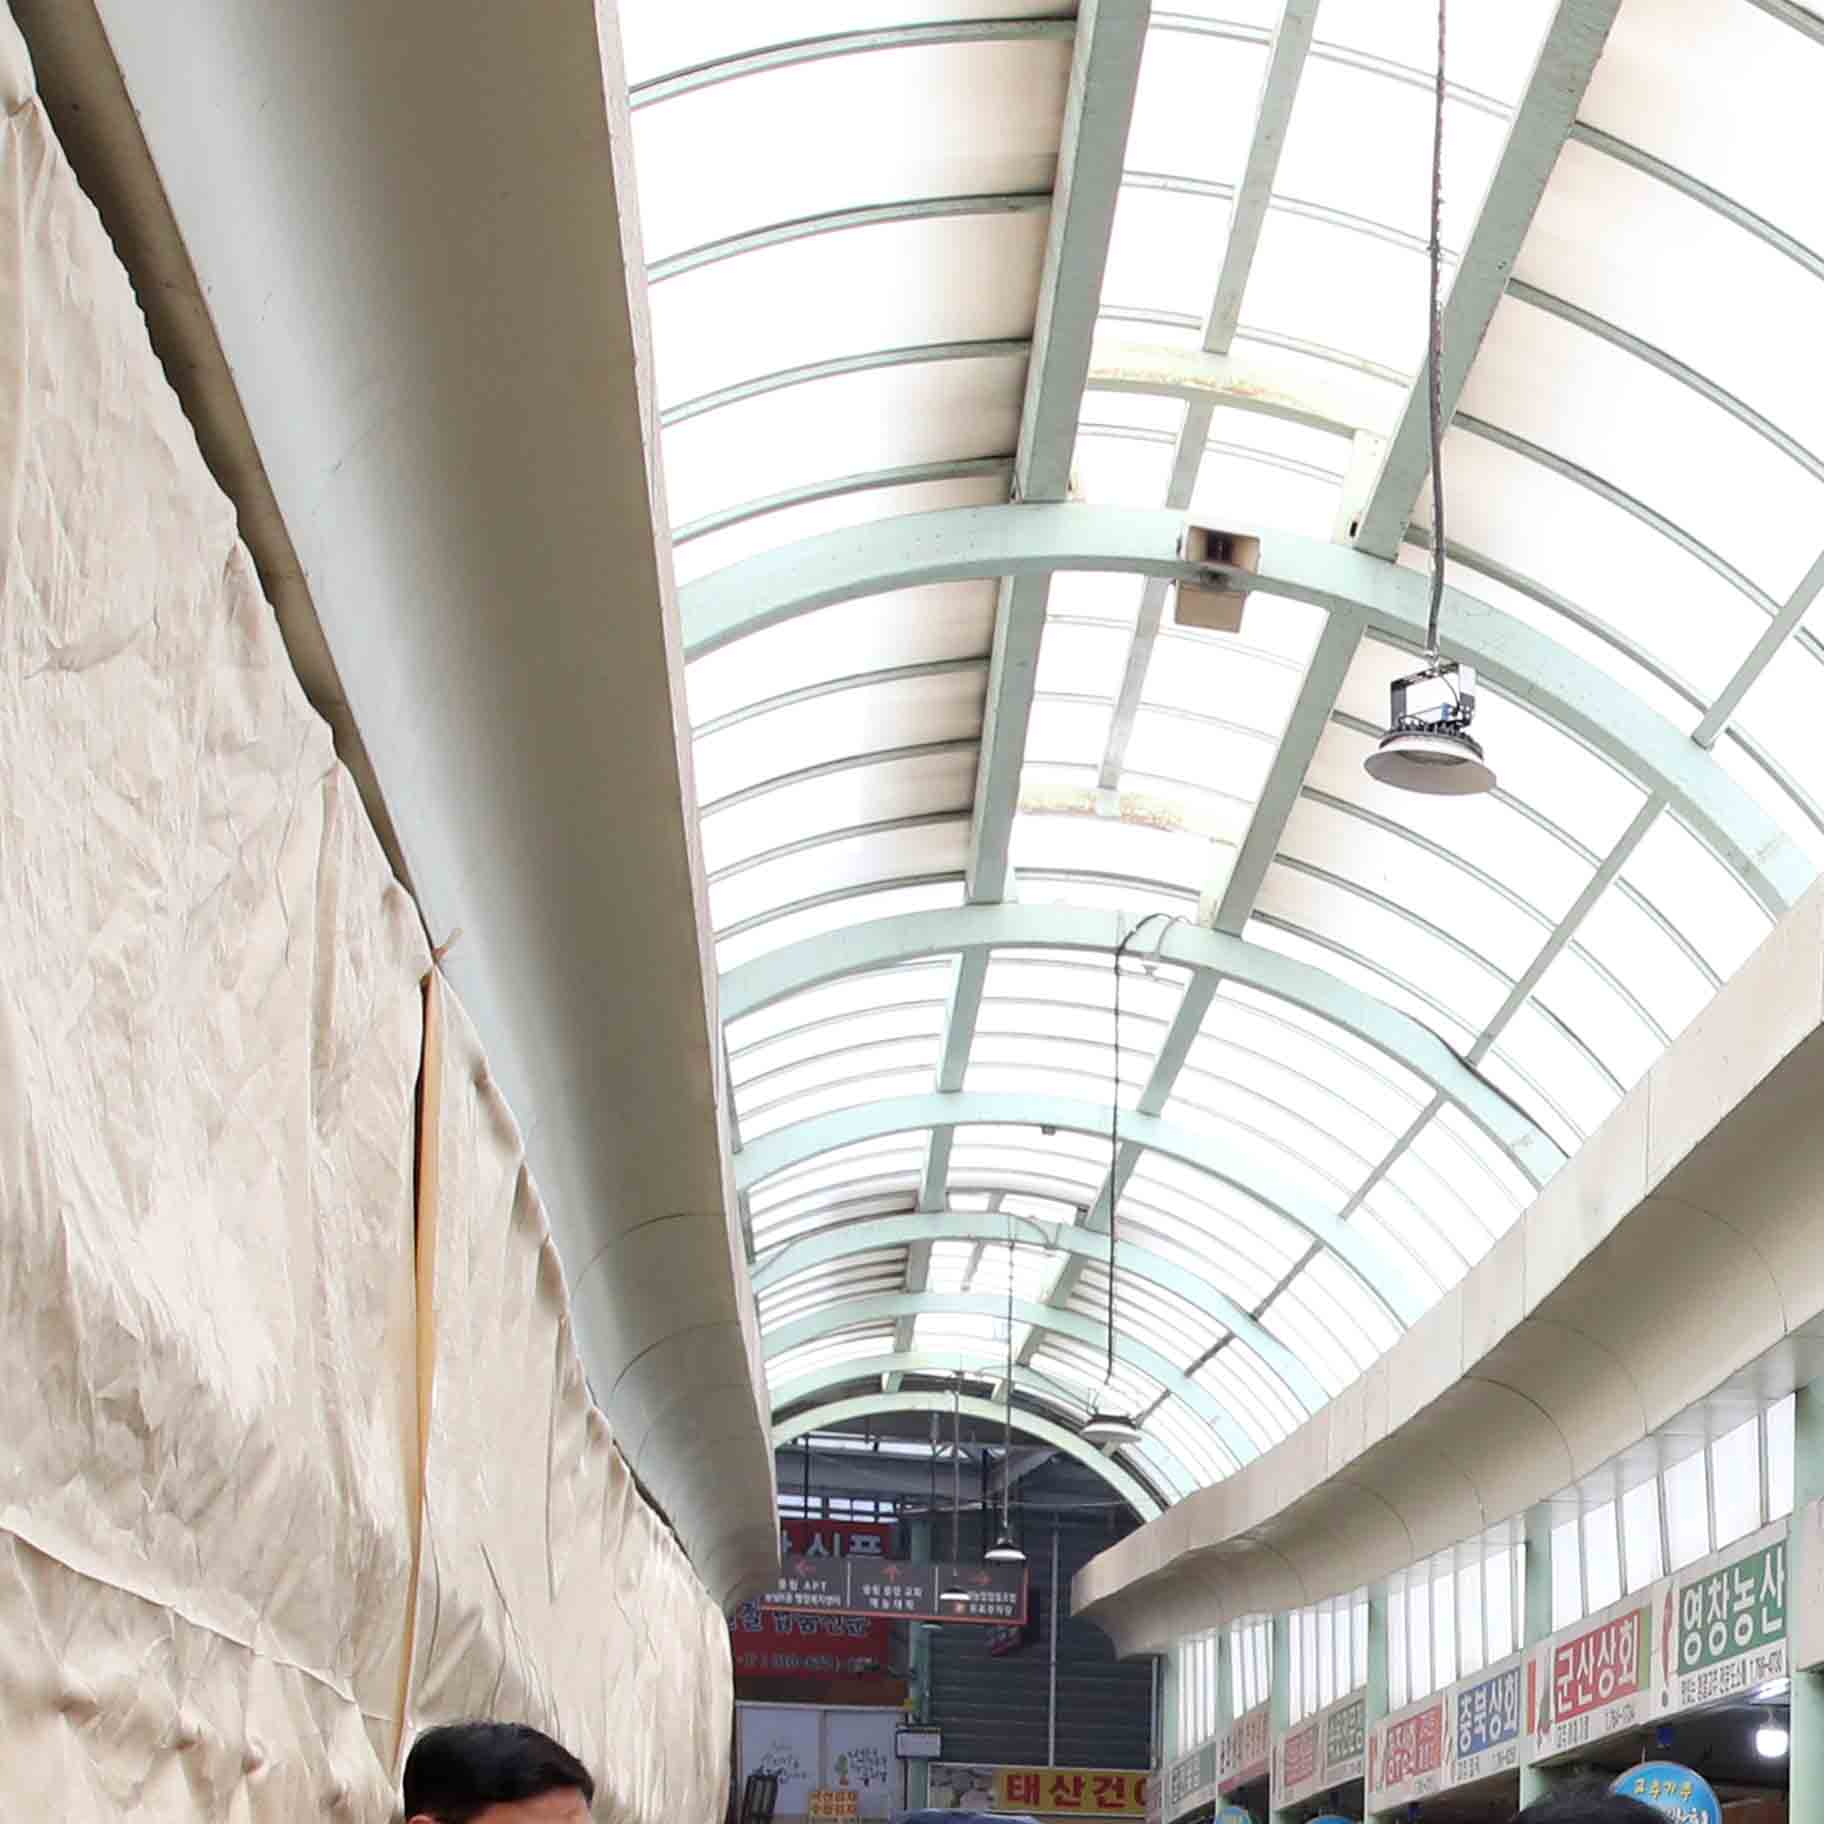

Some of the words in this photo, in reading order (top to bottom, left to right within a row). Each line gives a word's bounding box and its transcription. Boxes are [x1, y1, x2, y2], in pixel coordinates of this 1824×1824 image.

[1683, 1545, 1784, 1665] 영창농산
[1458, 1671, 1519, 1753] 충북상회
[1556, 1614, 1638, 1713] 군산상회
